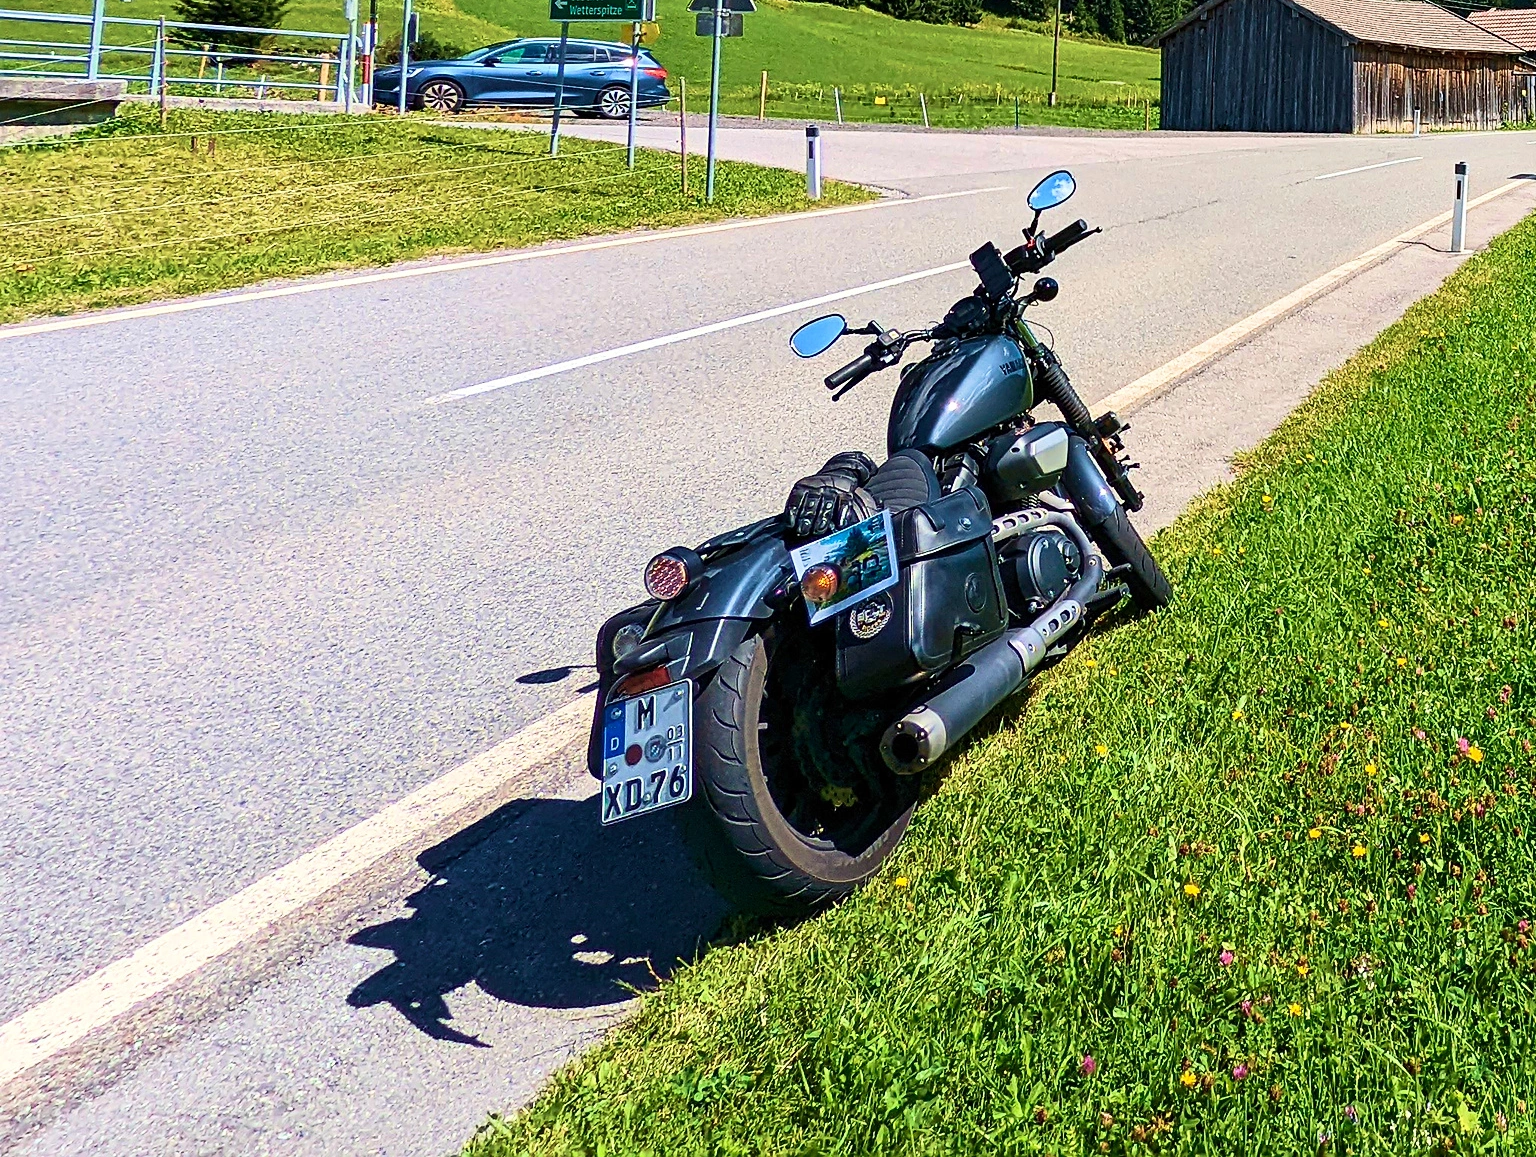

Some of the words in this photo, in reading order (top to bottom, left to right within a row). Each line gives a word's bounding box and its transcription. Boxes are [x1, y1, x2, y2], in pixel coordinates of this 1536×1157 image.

[569, 4, 623, 17] Wetterspitze
[637, 695, 656, 730] M
[610, 737, 620, 751] D
